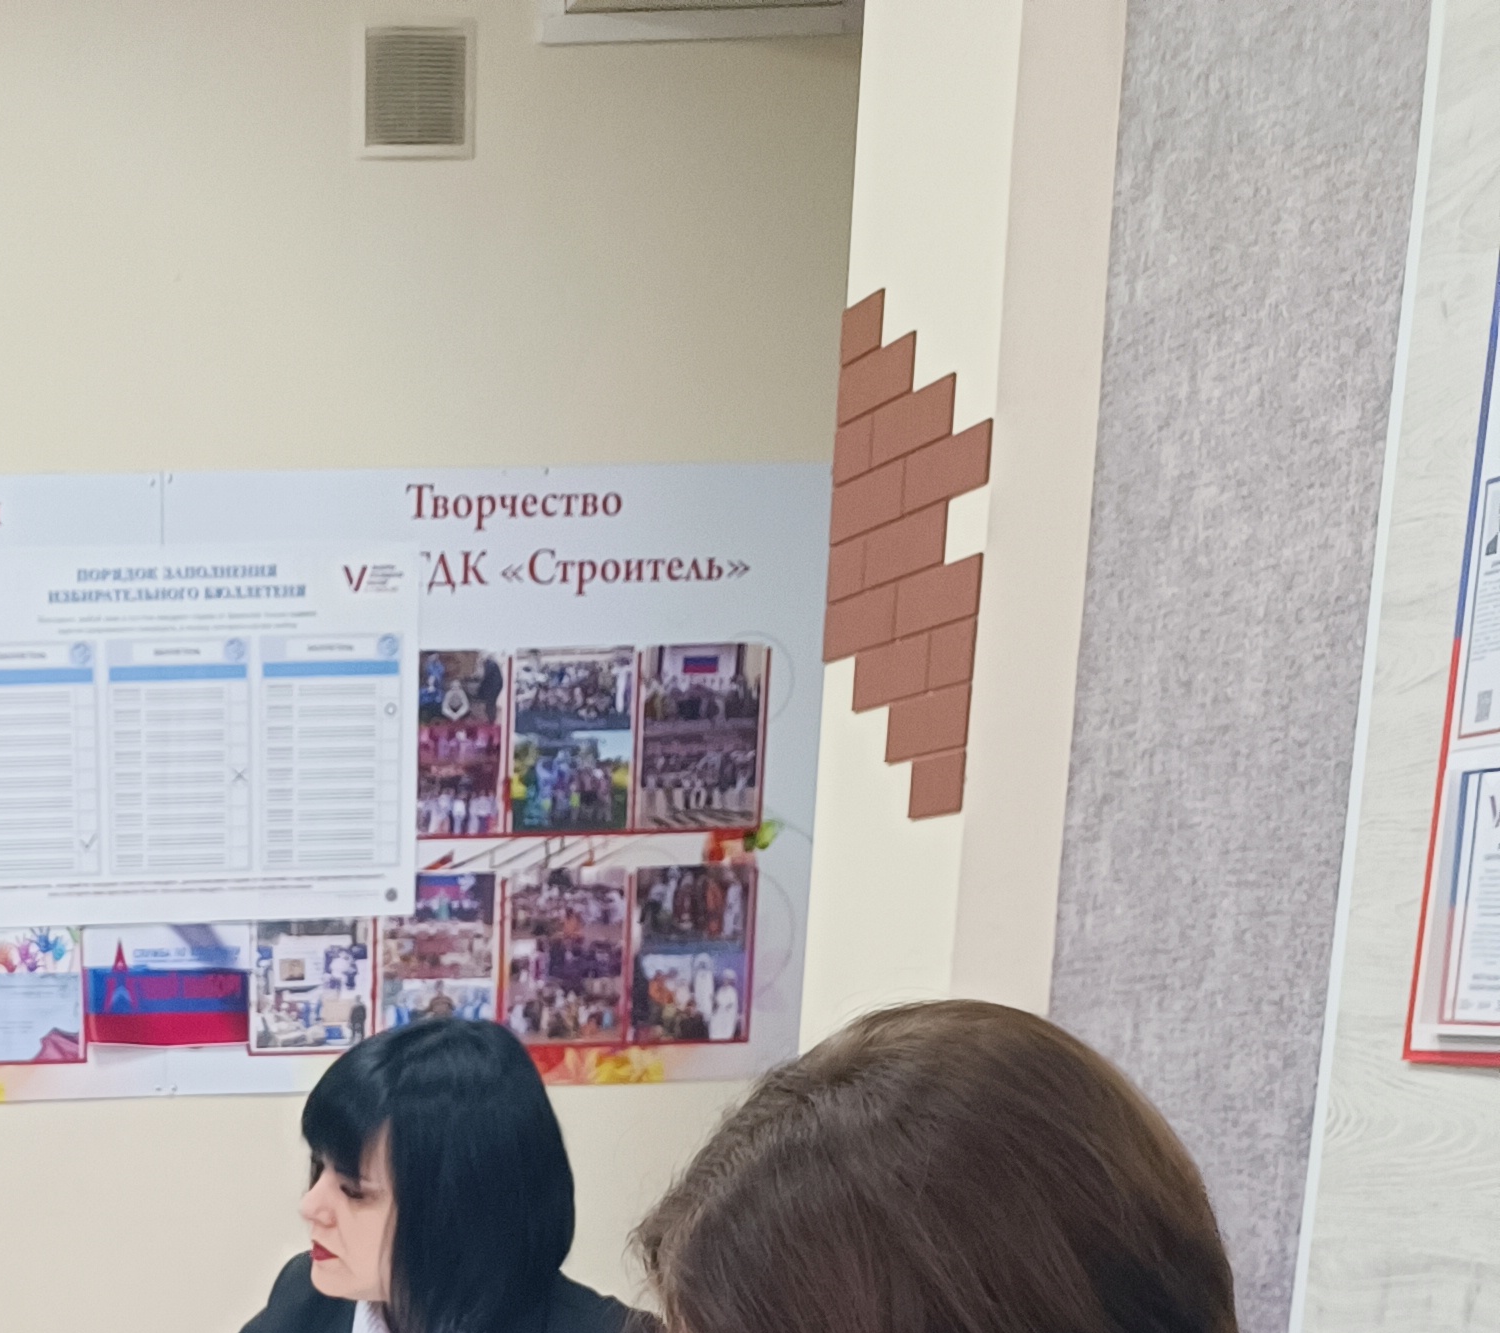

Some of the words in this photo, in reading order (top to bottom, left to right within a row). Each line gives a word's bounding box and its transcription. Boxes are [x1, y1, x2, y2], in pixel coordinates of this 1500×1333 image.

[406, 483, 622, 531] Творчество
[77, 566, 158, 583] ПОРЯДОК
[164, 564, 277, 581] ЗАПОЛНЕНИЯ
[501, 548, 750, 596] «Строитель»
[48, 585, 198, 604] ИЗБИРАТЕЛЬНОГО
[204, 584, 306, 600] БЮЛЛЕТЕНЯ
